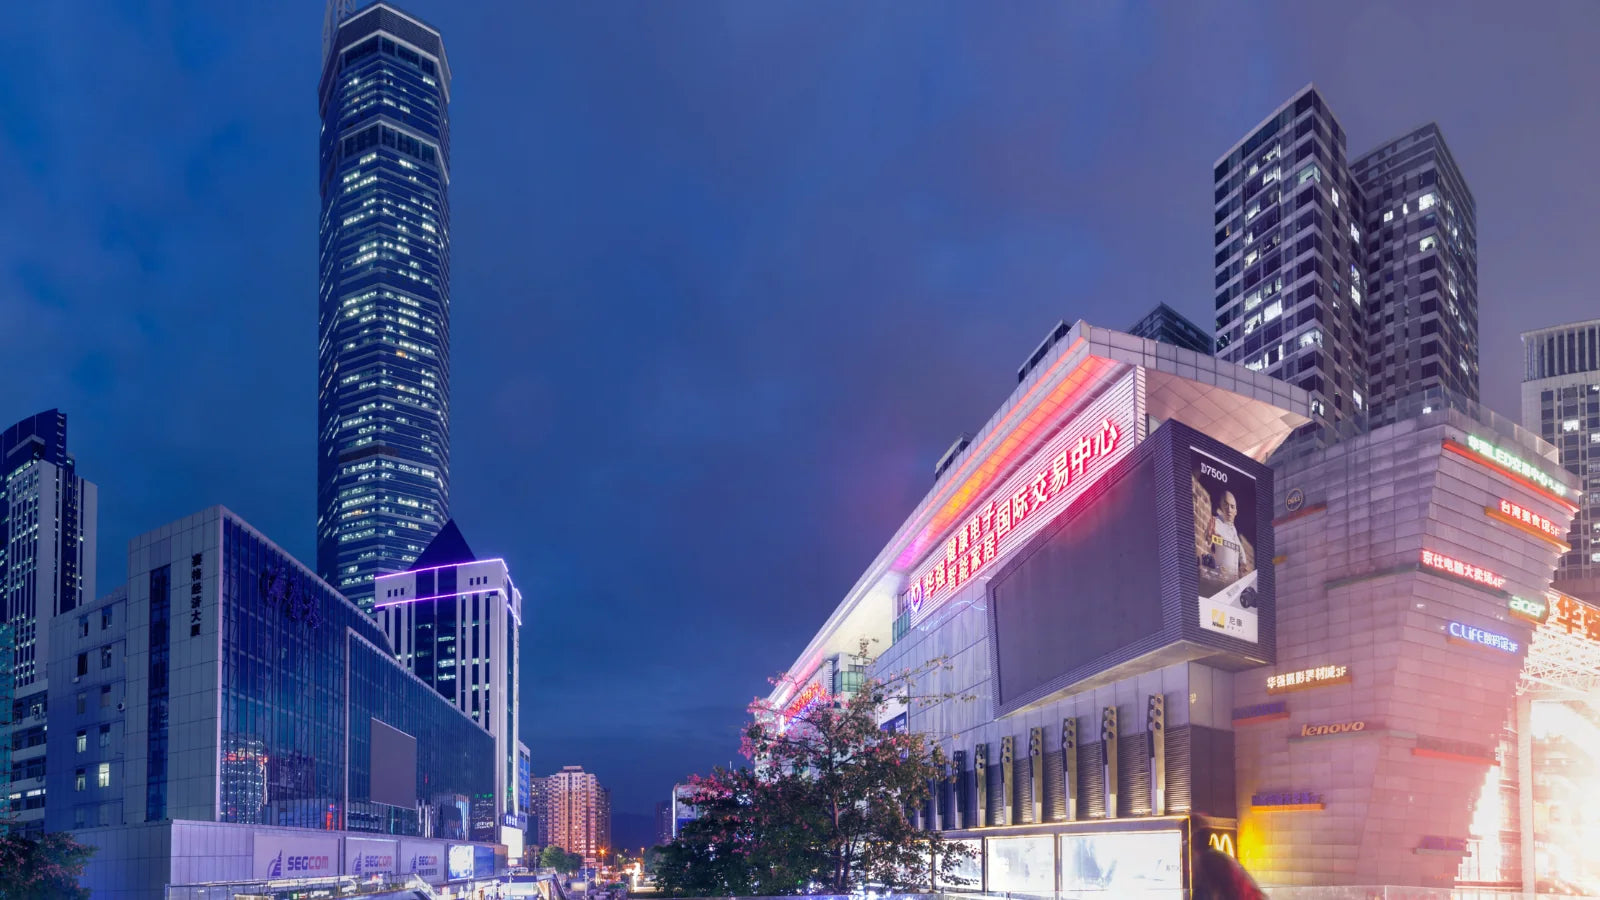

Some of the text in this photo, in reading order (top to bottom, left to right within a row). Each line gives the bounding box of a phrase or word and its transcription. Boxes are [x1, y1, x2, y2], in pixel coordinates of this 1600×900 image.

[997, 419, 1118, 539] 国际交易中心
[1200, 462, 1228, 483] D7500
[947, 533, 997, 592] 智能家居
[1509, 595, 1546, 617] acer
[1301, 721, 1365, 737] lenovo
[287, 855, 329, 871] SEGCOM
[364, 855, 393, 868] SEGCOM
[418, 855, 438, 866] SEGCOM
